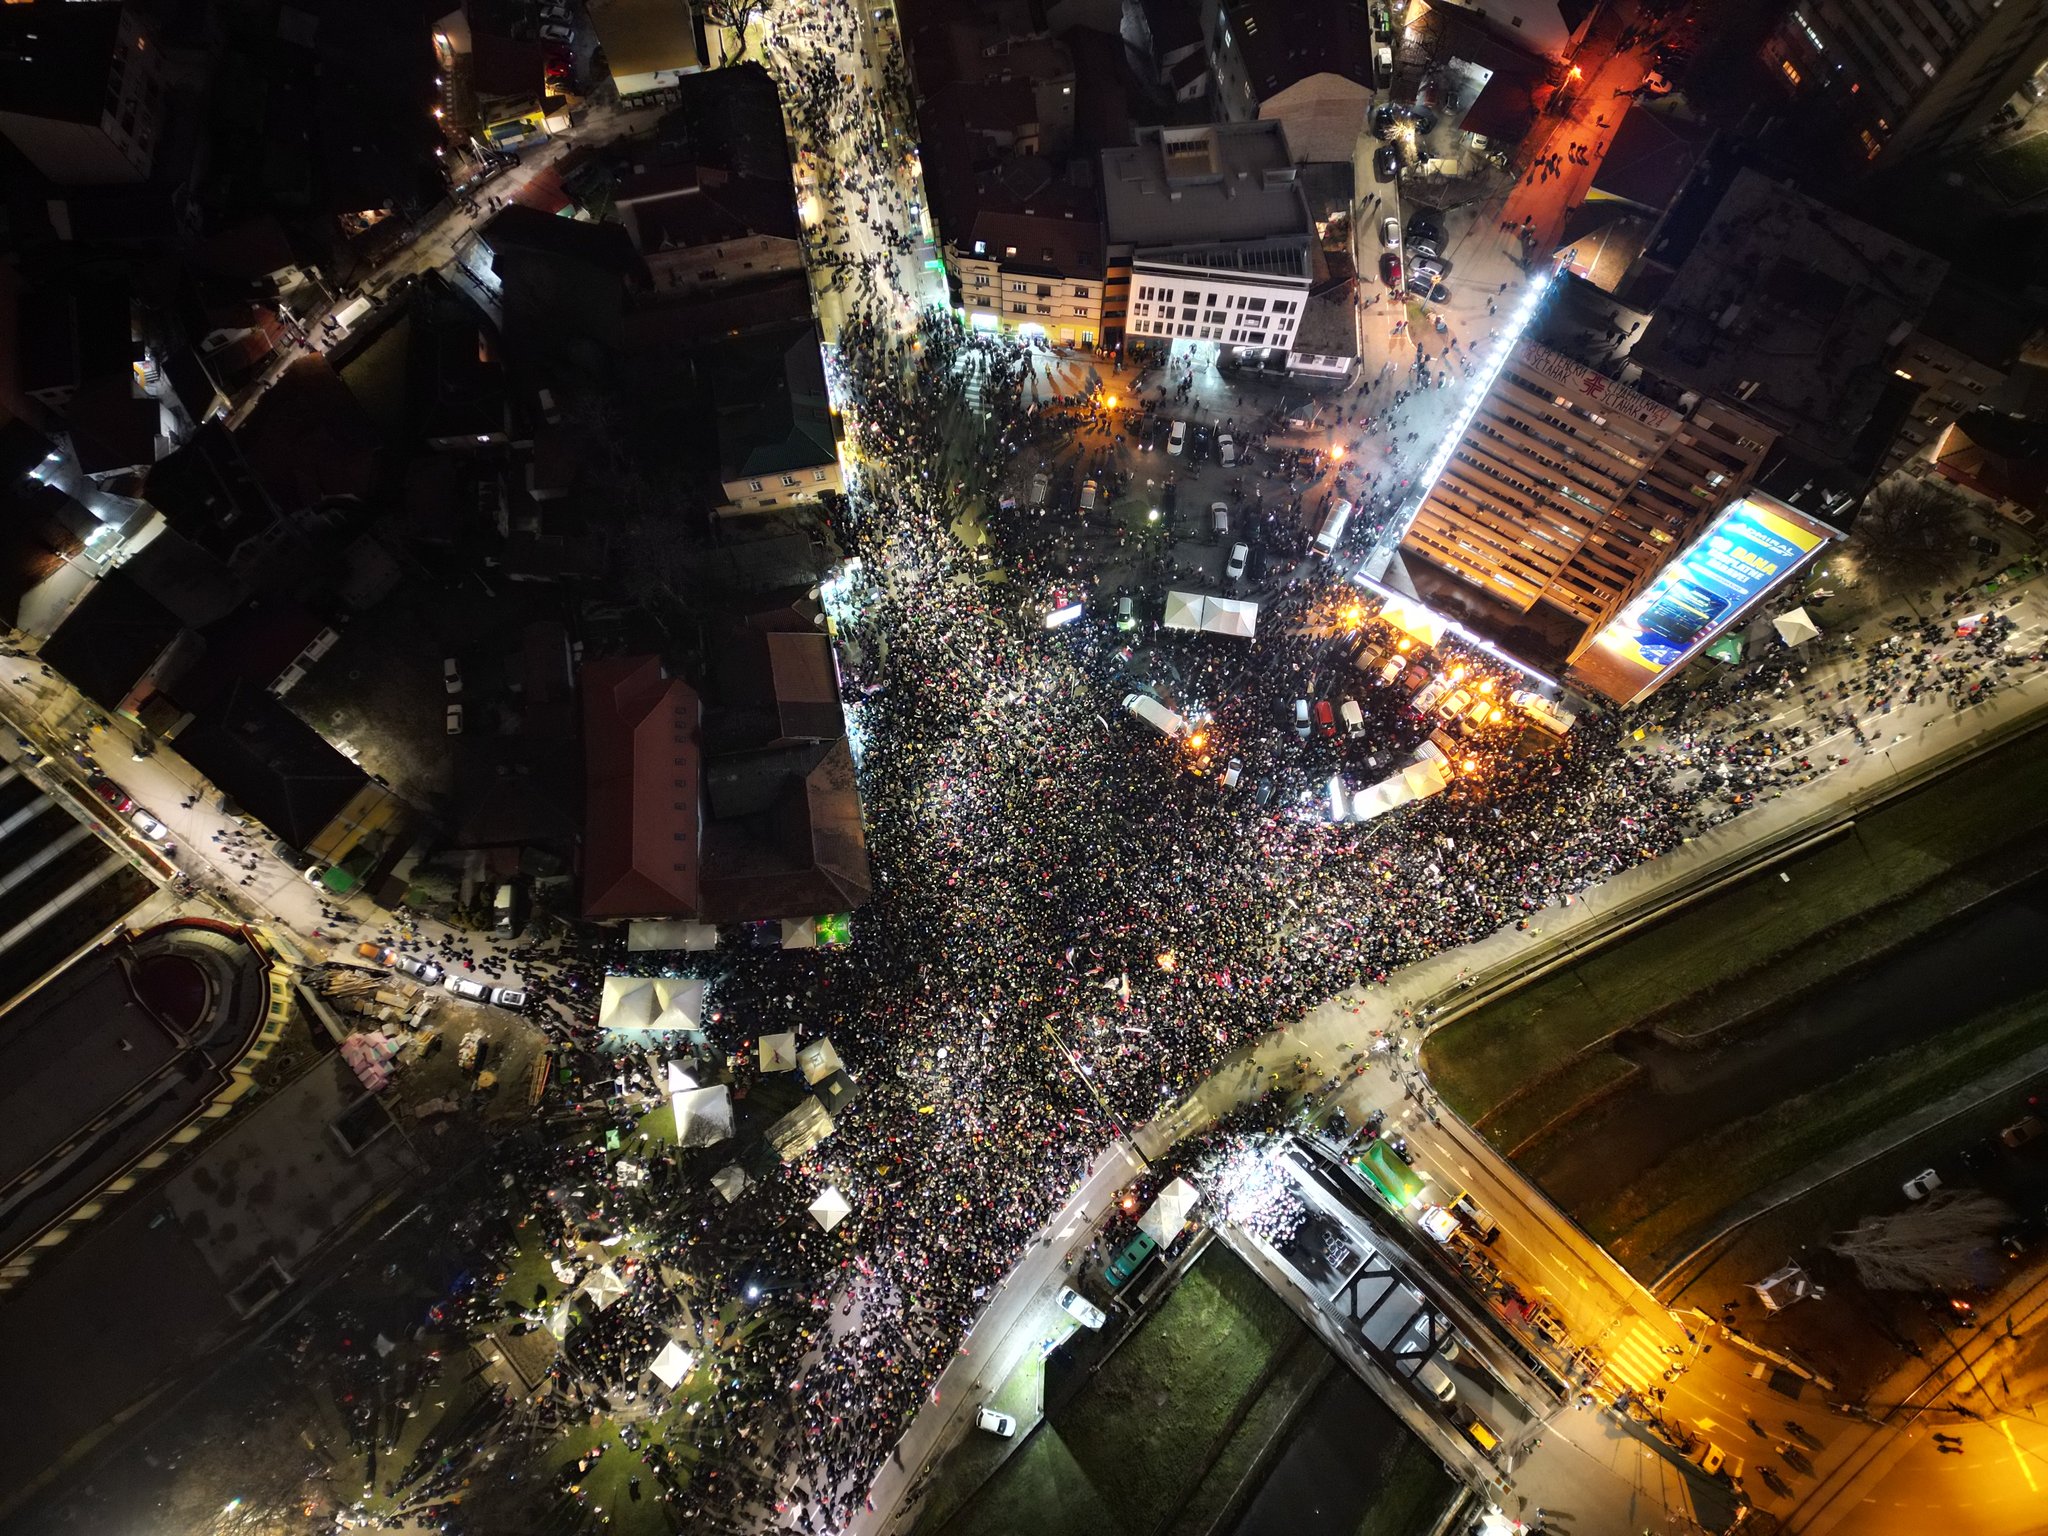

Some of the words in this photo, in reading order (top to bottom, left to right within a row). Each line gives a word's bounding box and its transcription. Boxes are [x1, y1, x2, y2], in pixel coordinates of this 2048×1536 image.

[1531, 356, 1571, 383] УСТАНАК
[1600, 391, 1641, 418] УСТАНАК
[1647, 417, 1664, 428] 24
[1607, 382, 1658, 414] СТУДЕНТСКИ
[1653, 406, 1672, 420] 20
[1707, 547, 1764, 580] PLATNE
[1729, 546, 1778, 576] DANA
